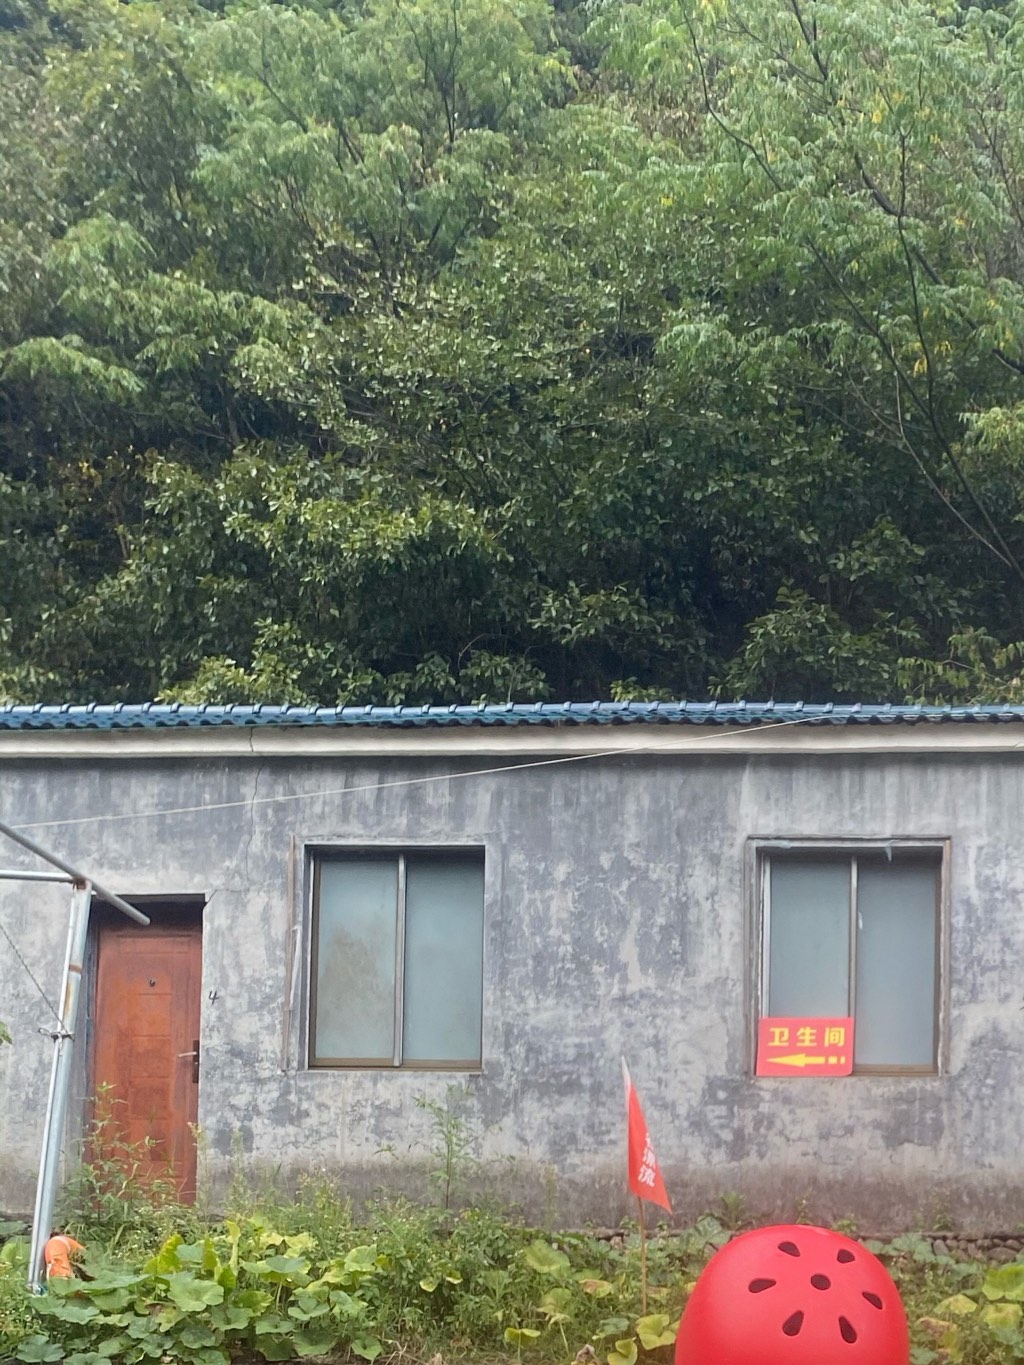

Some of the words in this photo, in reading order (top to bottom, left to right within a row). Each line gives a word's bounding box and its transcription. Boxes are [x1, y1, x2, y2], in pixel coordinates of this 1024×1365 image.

[208, 990, 219, 1006] 4
[768, 1026, 845, 1047] 卫生间
